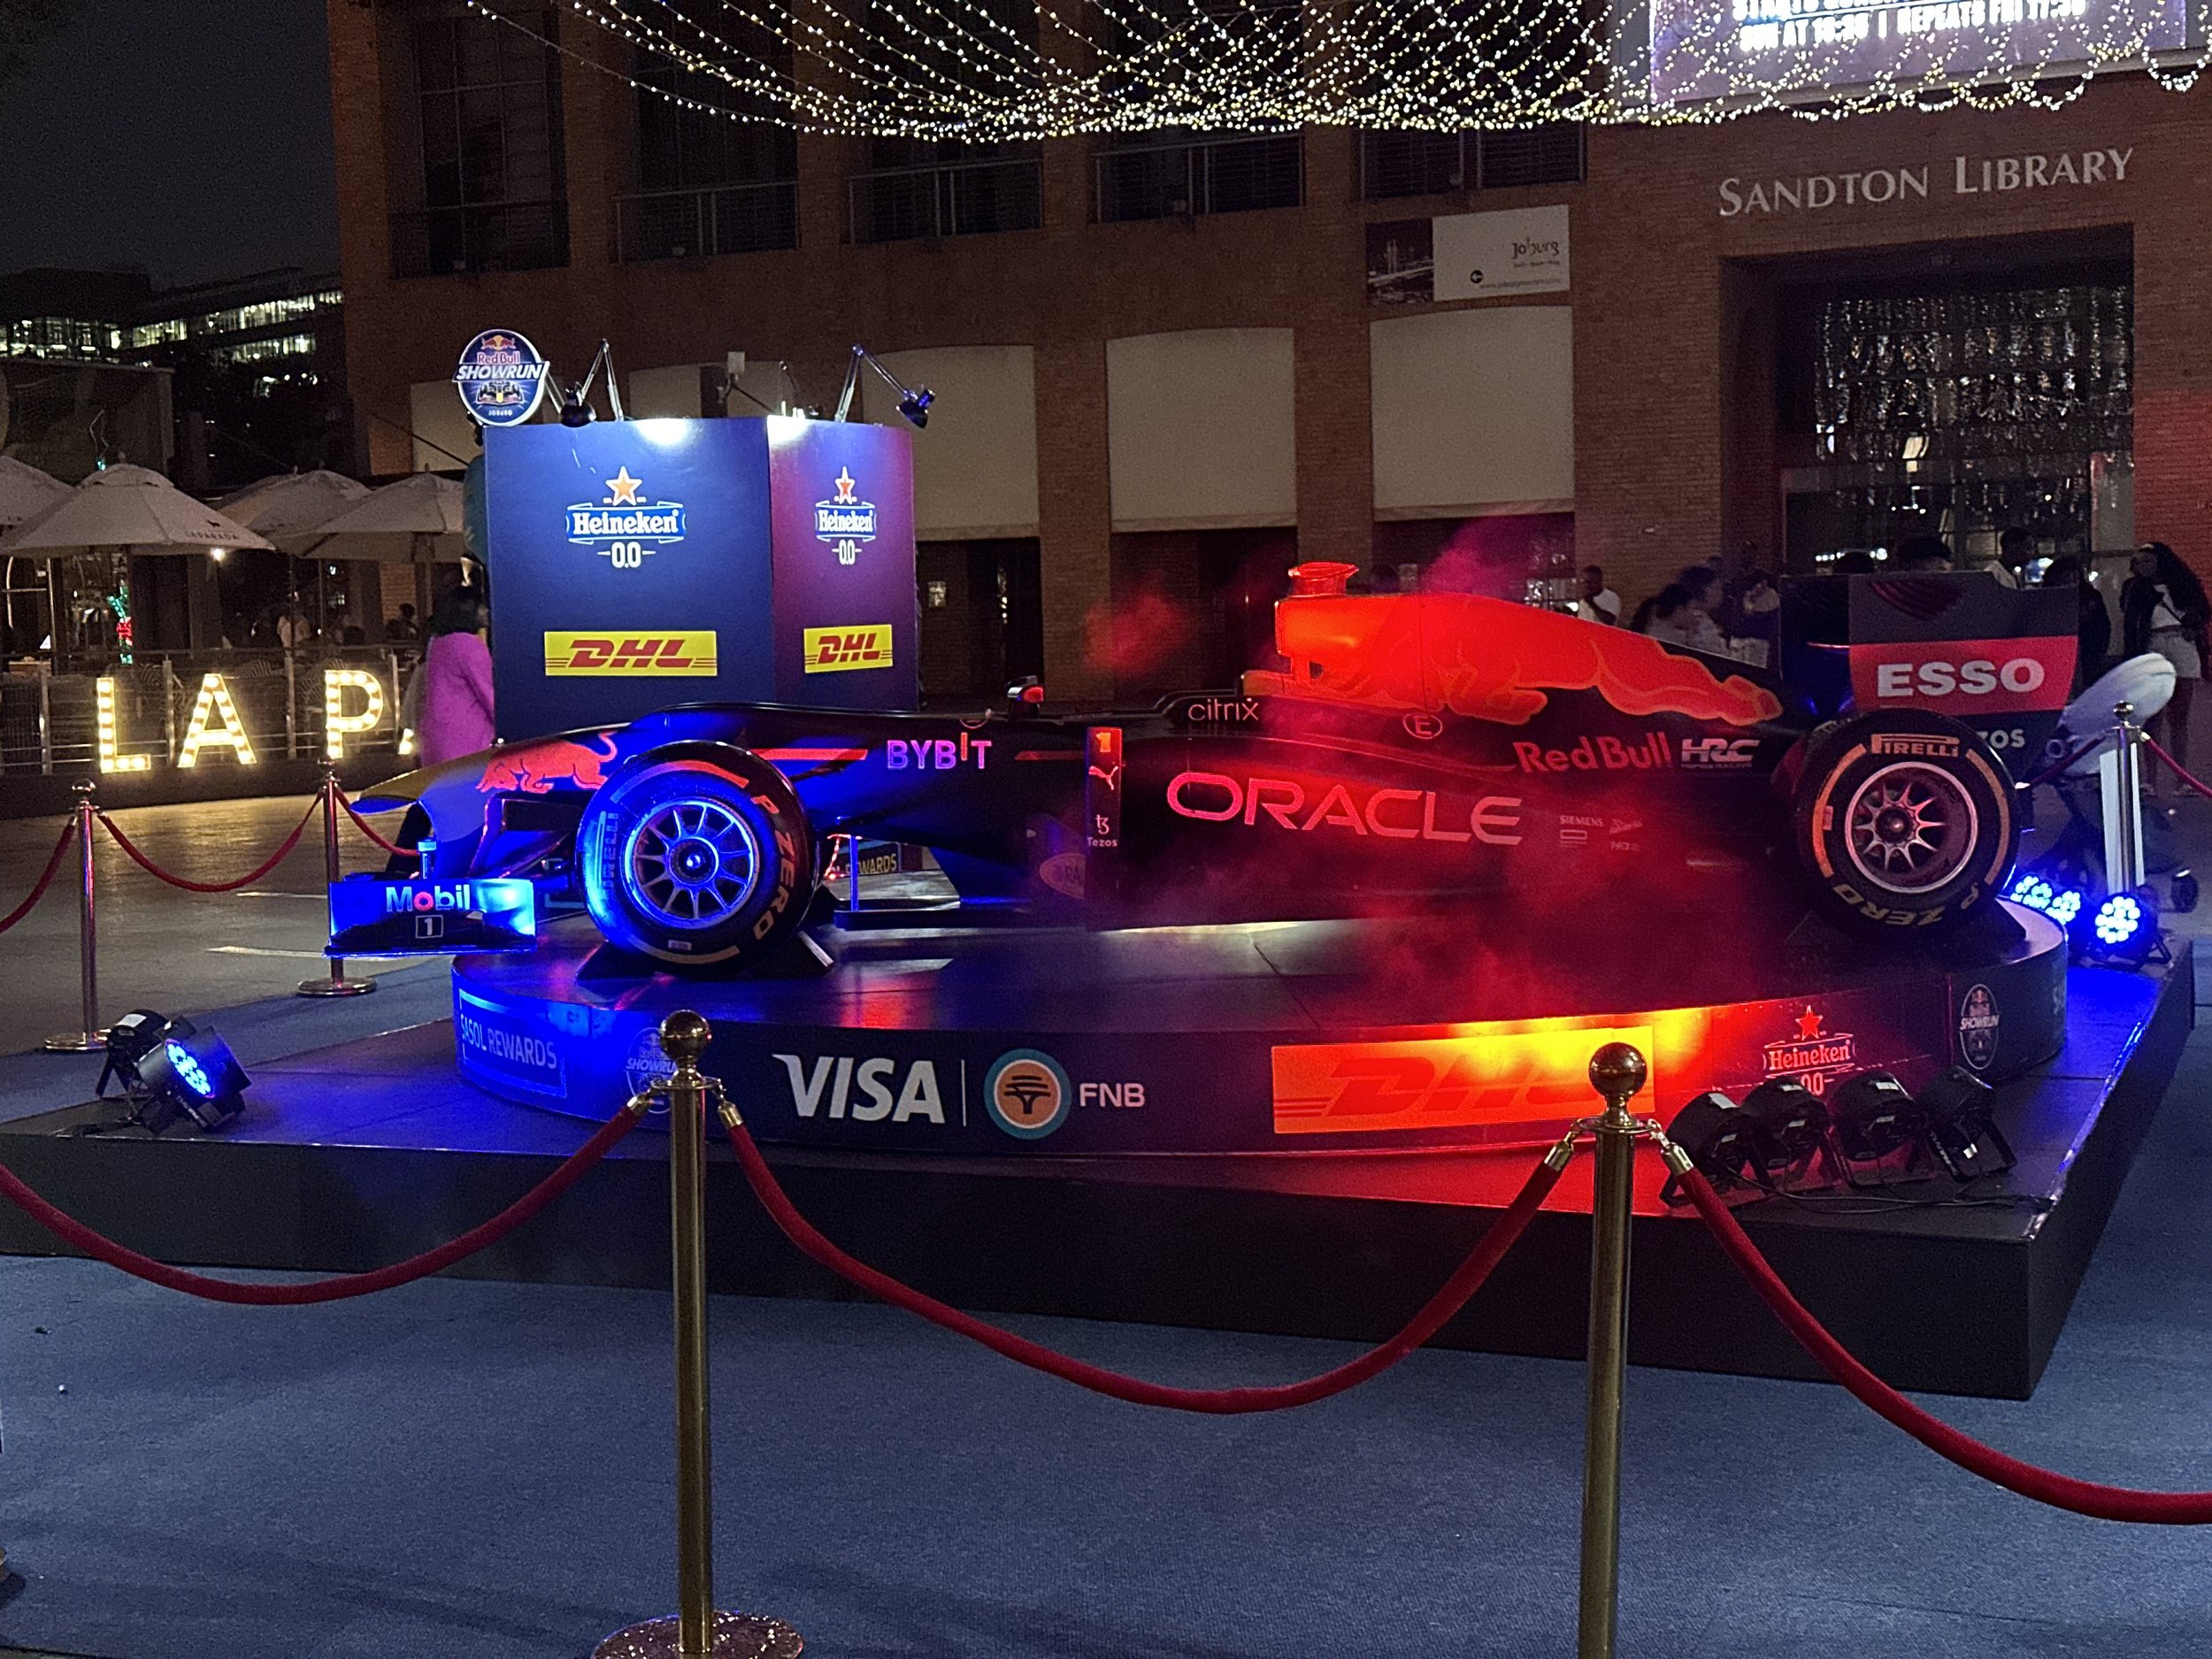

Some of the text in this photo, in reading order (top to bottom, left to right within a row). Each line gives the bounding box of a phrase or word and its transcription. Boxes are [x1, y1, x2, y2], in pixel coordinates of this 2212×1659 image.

[1783, 19, 1809, 47] AT
[1897, 1, 1985, 35] REPEATS
[478, 351, 520, 365] Red Bull
[457, 364, 542, 380] SHOWRUN
[572, 510, 679, 534] Heineken
[818, 510, 873, 533] Heineken
[611, 541, 641, 568] 0.0
[839, 540, 856, 565] 0.0
[568, 640, 694, 668] DHL
[817, 633, 880, 664] DHL
[1877, 657, 2045, 697] ESSO
[1188, 698, 1258, 721] citrix
[887, 733, 992, 769] BYBIT
[1096, 733, 1111, 752] 1
[1513, 732, 1673, 772] Red Bull
[1870, 733, 1960, 757] PIRELLI
[1167, 772, 1522, 845] ORACLE
[1559, 814, 1603, 827] SIEMENS
[1087, 836, 1118, 847] Tezos
[750, 795, 795, 940] P ZERO
[386, 884, 471, 912] Mobil
[1832, 884, 1946, 926] ZERO
[425, 918, 434, 935] 1
[460, 1013, 557, 1069] SASOL REWARDS
[626, 1057, 679, 1073] SHOWRU
[1768, 1041, 1851, 1071] Heineken
[772, 1053, 946, 1125] VISA
[1079, 1082, 1146, 1109] FNB
